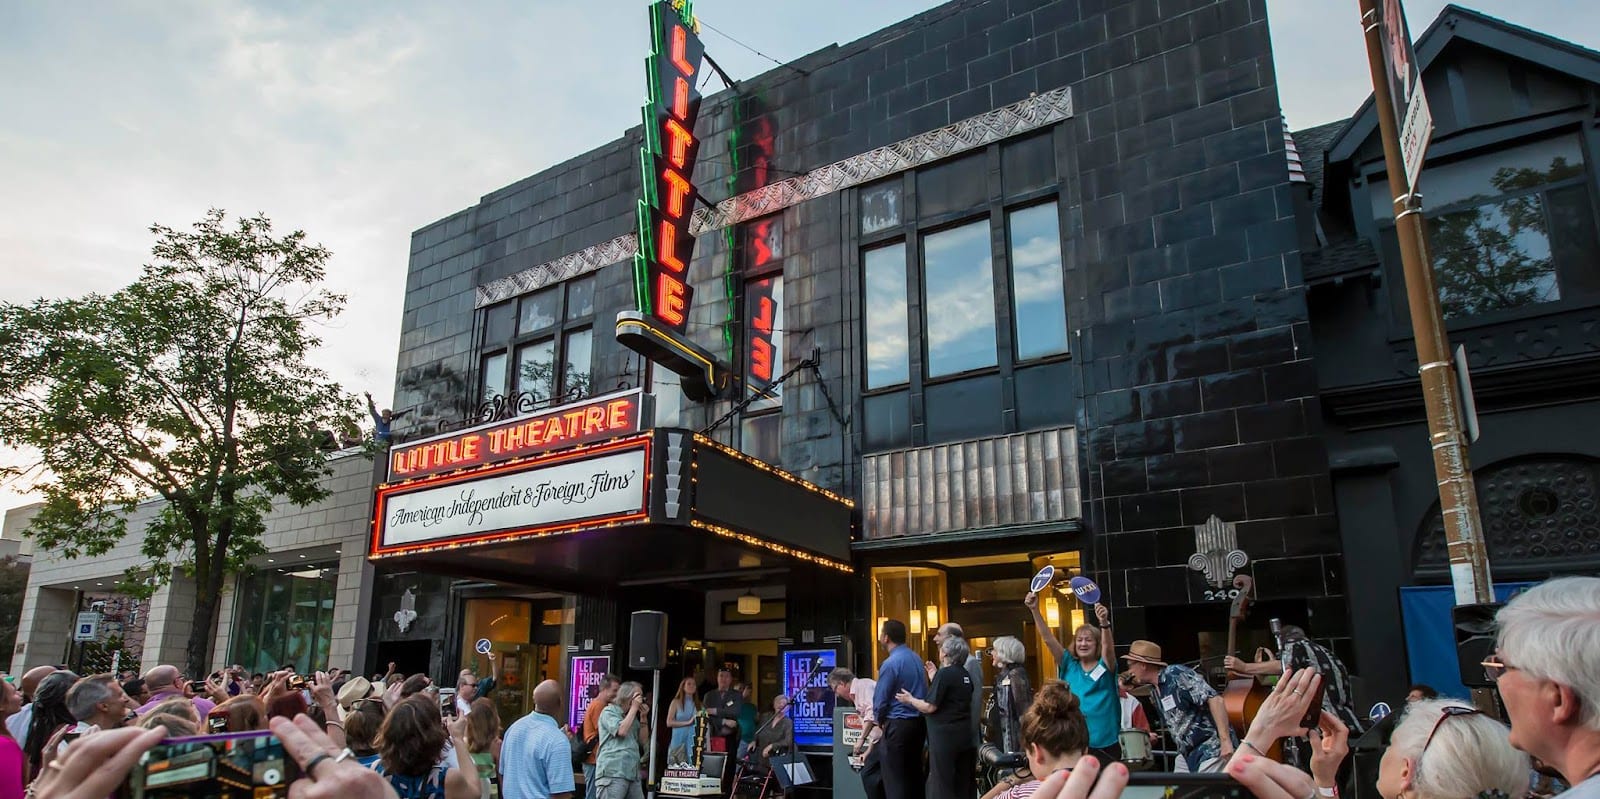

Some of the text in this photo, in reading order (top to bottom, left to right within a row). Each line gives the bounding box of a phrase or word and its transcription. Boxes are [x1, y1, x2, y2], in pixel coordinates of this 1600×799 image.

[658, 24, 694, 326] LITTLE
[393, 399, 631, 475] LITTLE THEATRE
[391, 505, 446, 528] American
[446, 486, 522, 527] Independent
[532, 480, 586, 508] Foreign
[587, 470, 636, 500] Films
[1204, 589, 1240, 601] 240
[580, 660, 594, 673] LET
[792, 658, 811, 673] LET
[793, 702, 826, 718] LIGHT
